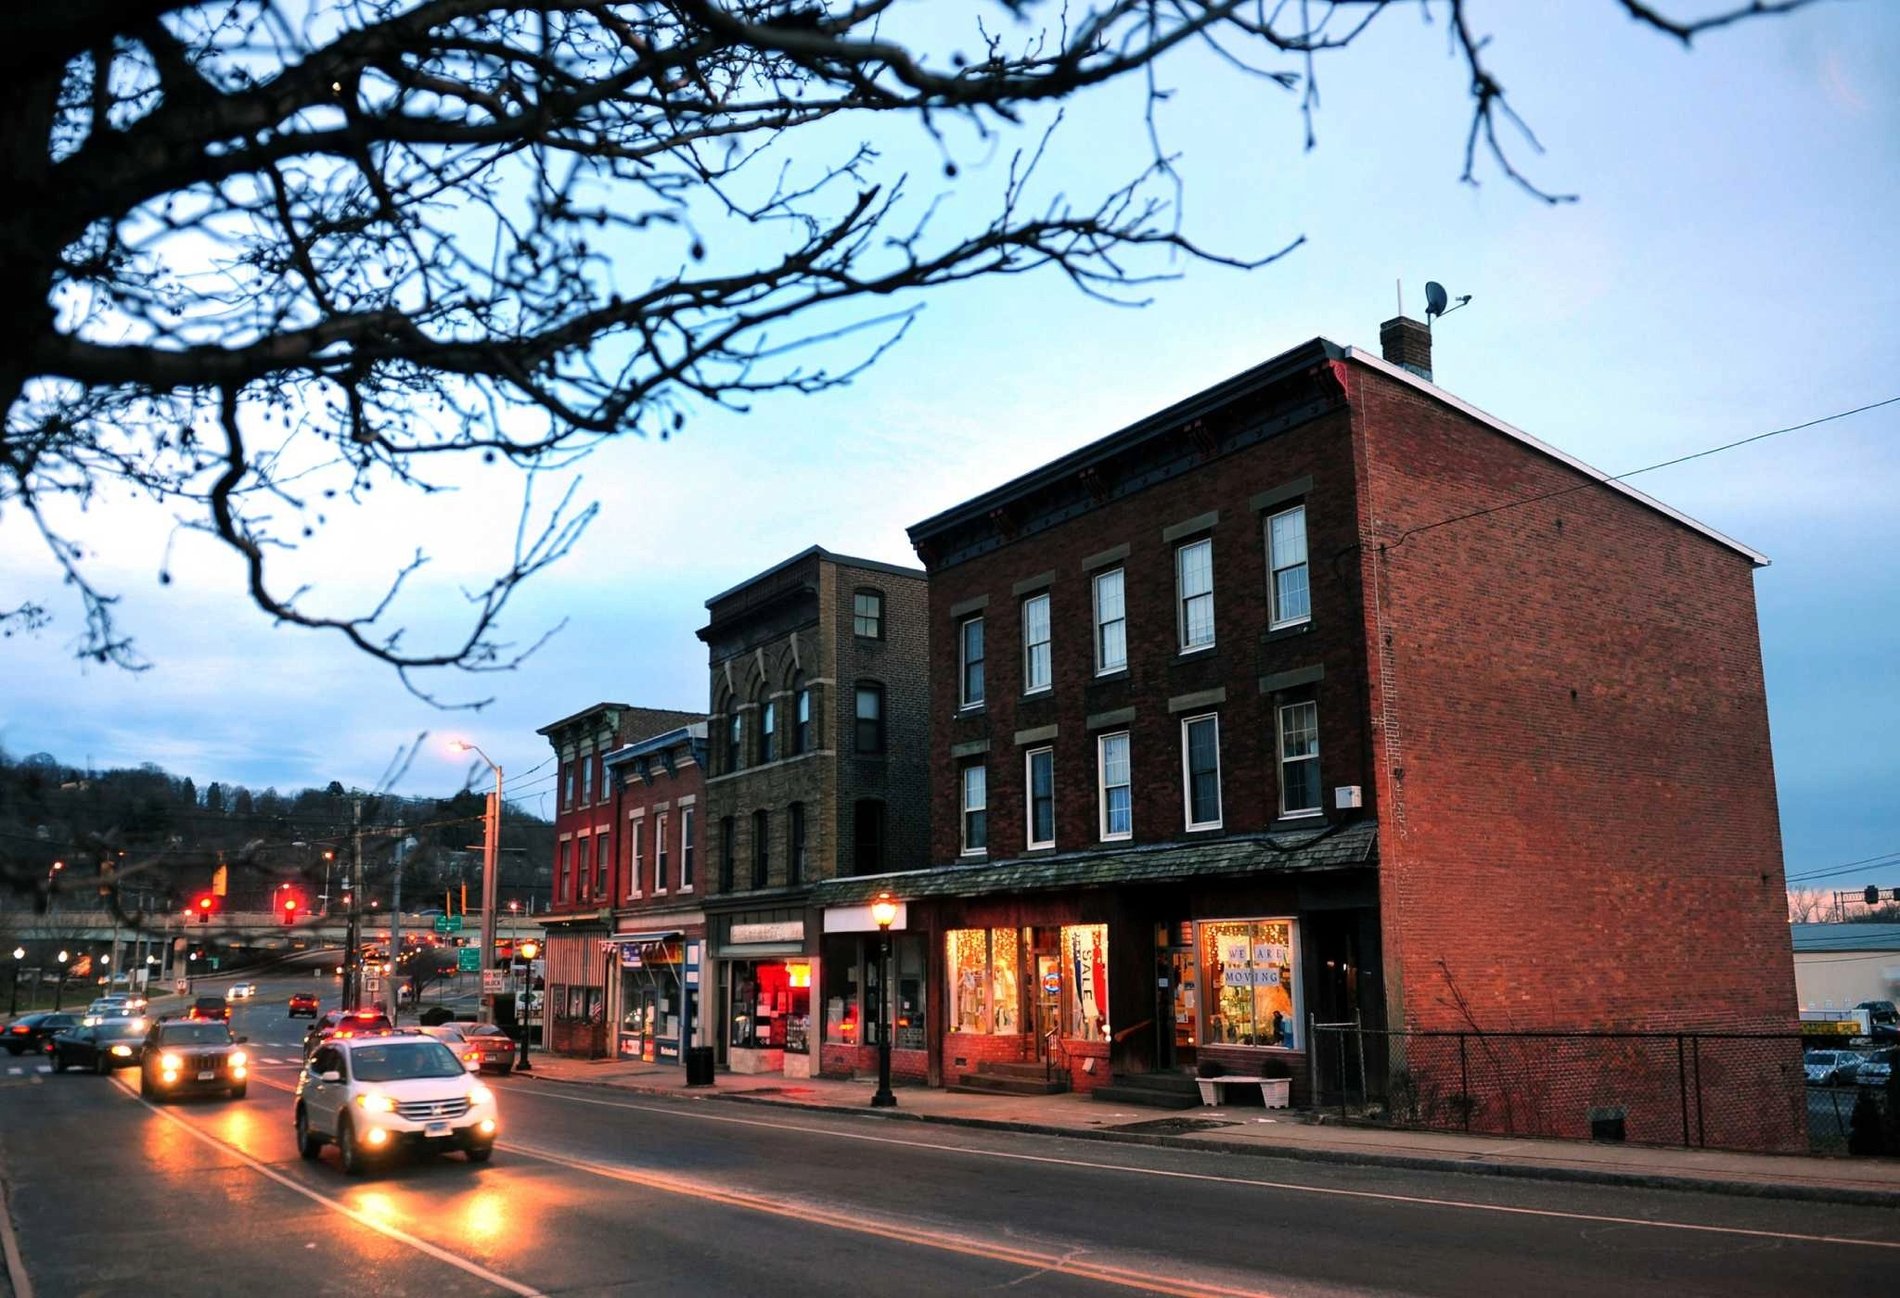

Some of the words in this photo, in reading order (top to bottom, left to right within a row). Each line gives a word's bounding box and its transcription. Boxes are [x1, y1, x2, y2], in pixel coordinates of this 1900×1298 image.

[1229, 949, 1245, 958] WE
[1257, 949, 1282, 958] ARE
[1082, 950, 1092, 1001] SALE
[1225, 972, 1277, 982] MOVING
